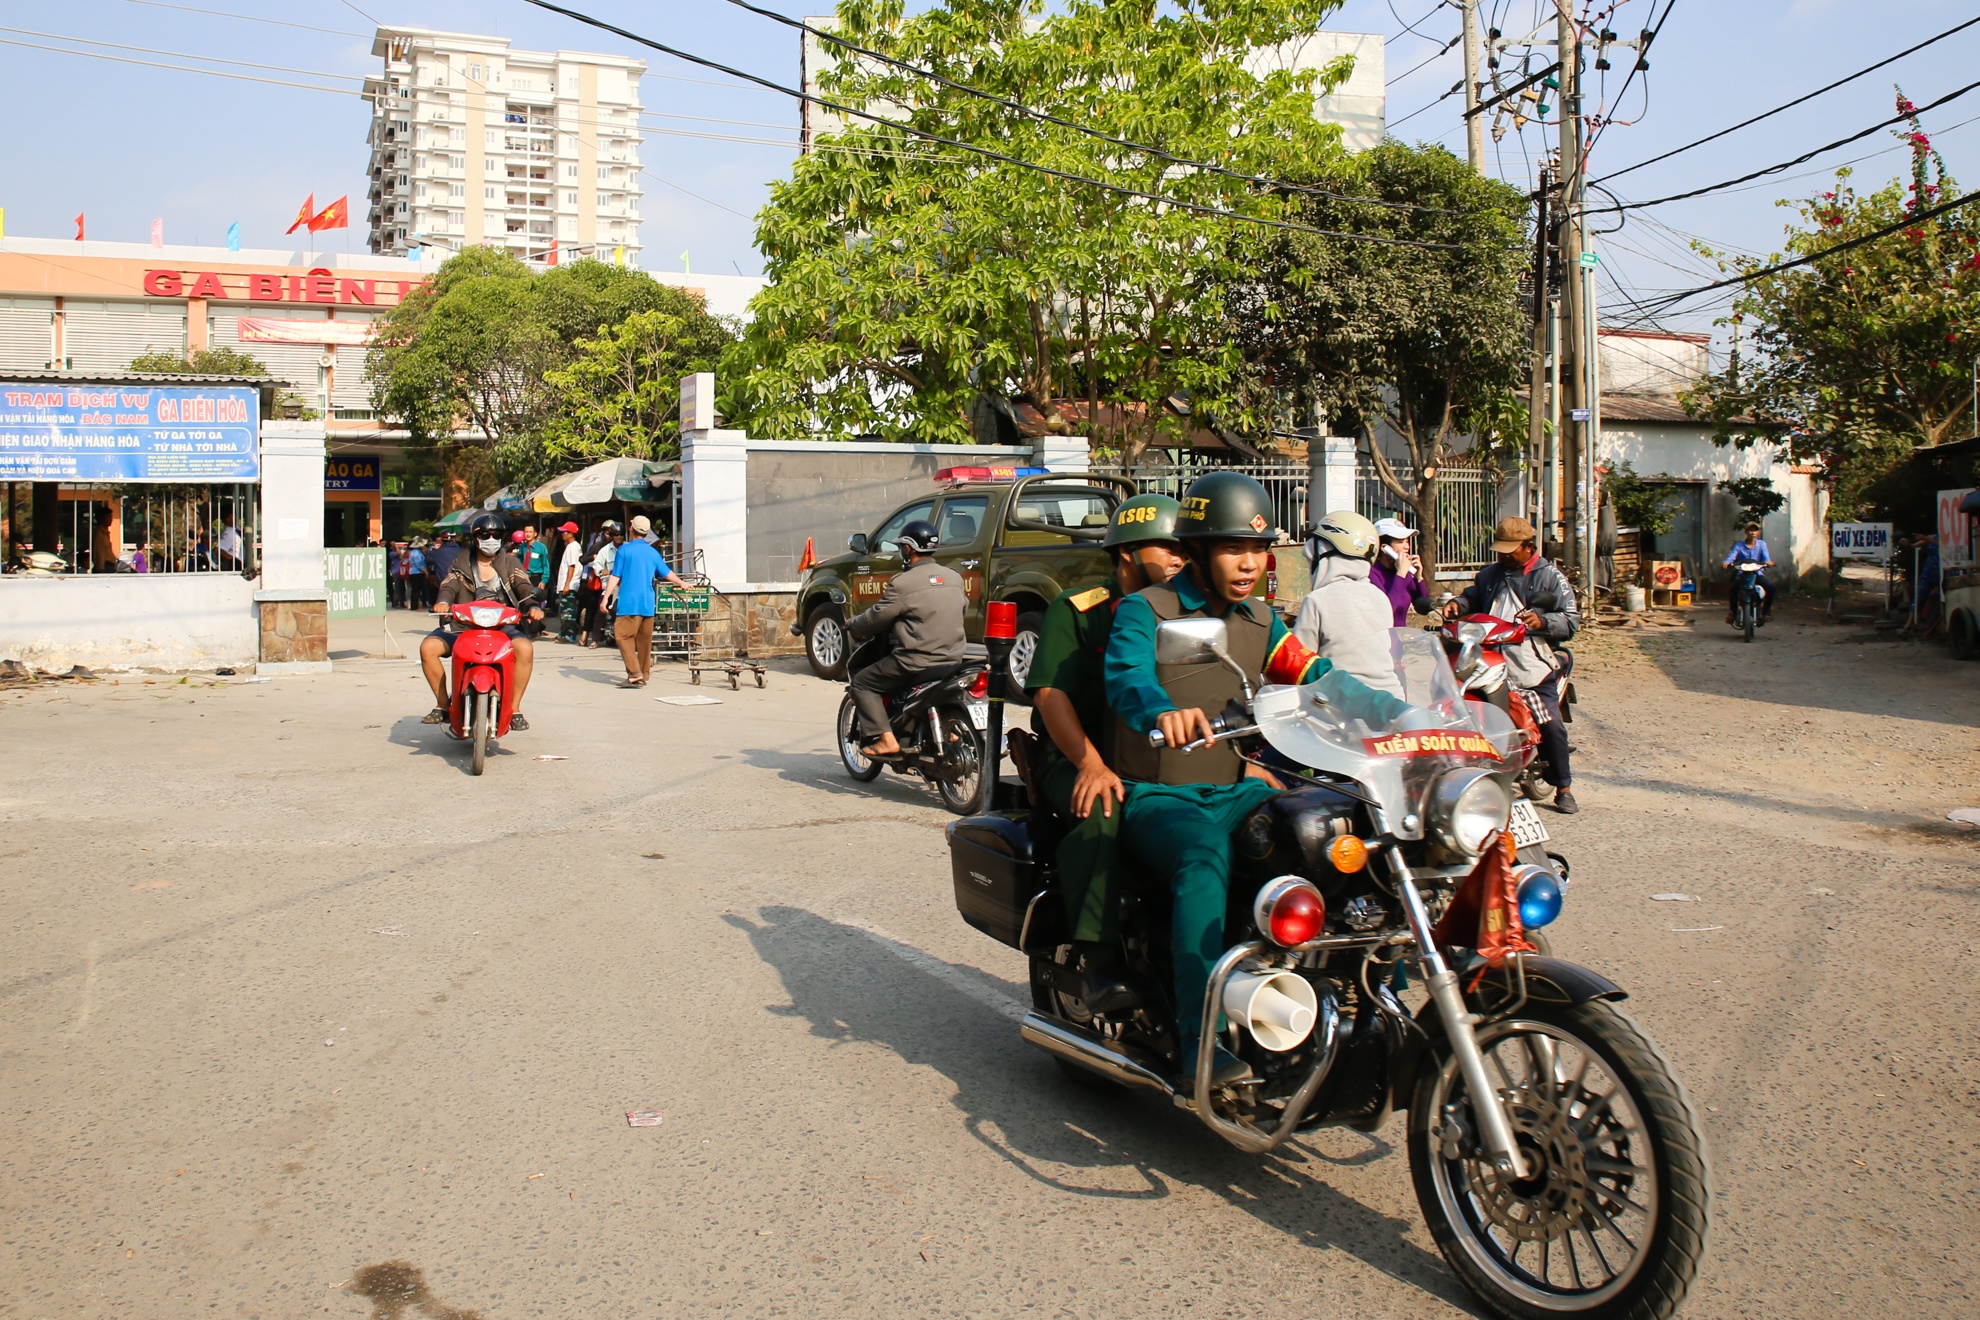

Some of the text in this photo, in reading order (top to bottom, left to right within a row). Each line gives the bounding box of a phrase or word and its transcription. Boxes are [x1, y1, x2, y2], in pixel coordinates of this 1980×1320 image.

[144, 269, 228, 299] GA
[249, 268, 375, 305] BIÊN
[5, 392, 149, 411] TRẠM DỊCH VỤ
[158, 398, 179, 422] GA
[181, 394, 215, 422] BIÊN
[115, 414, 148, 424] NAM
[0, 432, 19, 449] IỆN
[22, 434, 49, 447] GIAO
[85, 433, 115, 448] HÀNG
[171, 431, 186, 440] GA
[208, 431, 223, 440] GA
[171, 442, 193, 452] NHÀ
[216, 442, 237, 452] NHÀ
[325, 460, 374, 478] ÀO GA
[1117, 506, 1157, 526] KSQS
[1852, 530, 1865, 547] XE
[368, 554, 383, 580] XE
[859, 576, 881, 595] KIỂM
[333, 587, 354, 611] BIÊN
[1373, 733, 1419, 755] KIỂM
[1420, 732, 1456, 751] SOÁT
